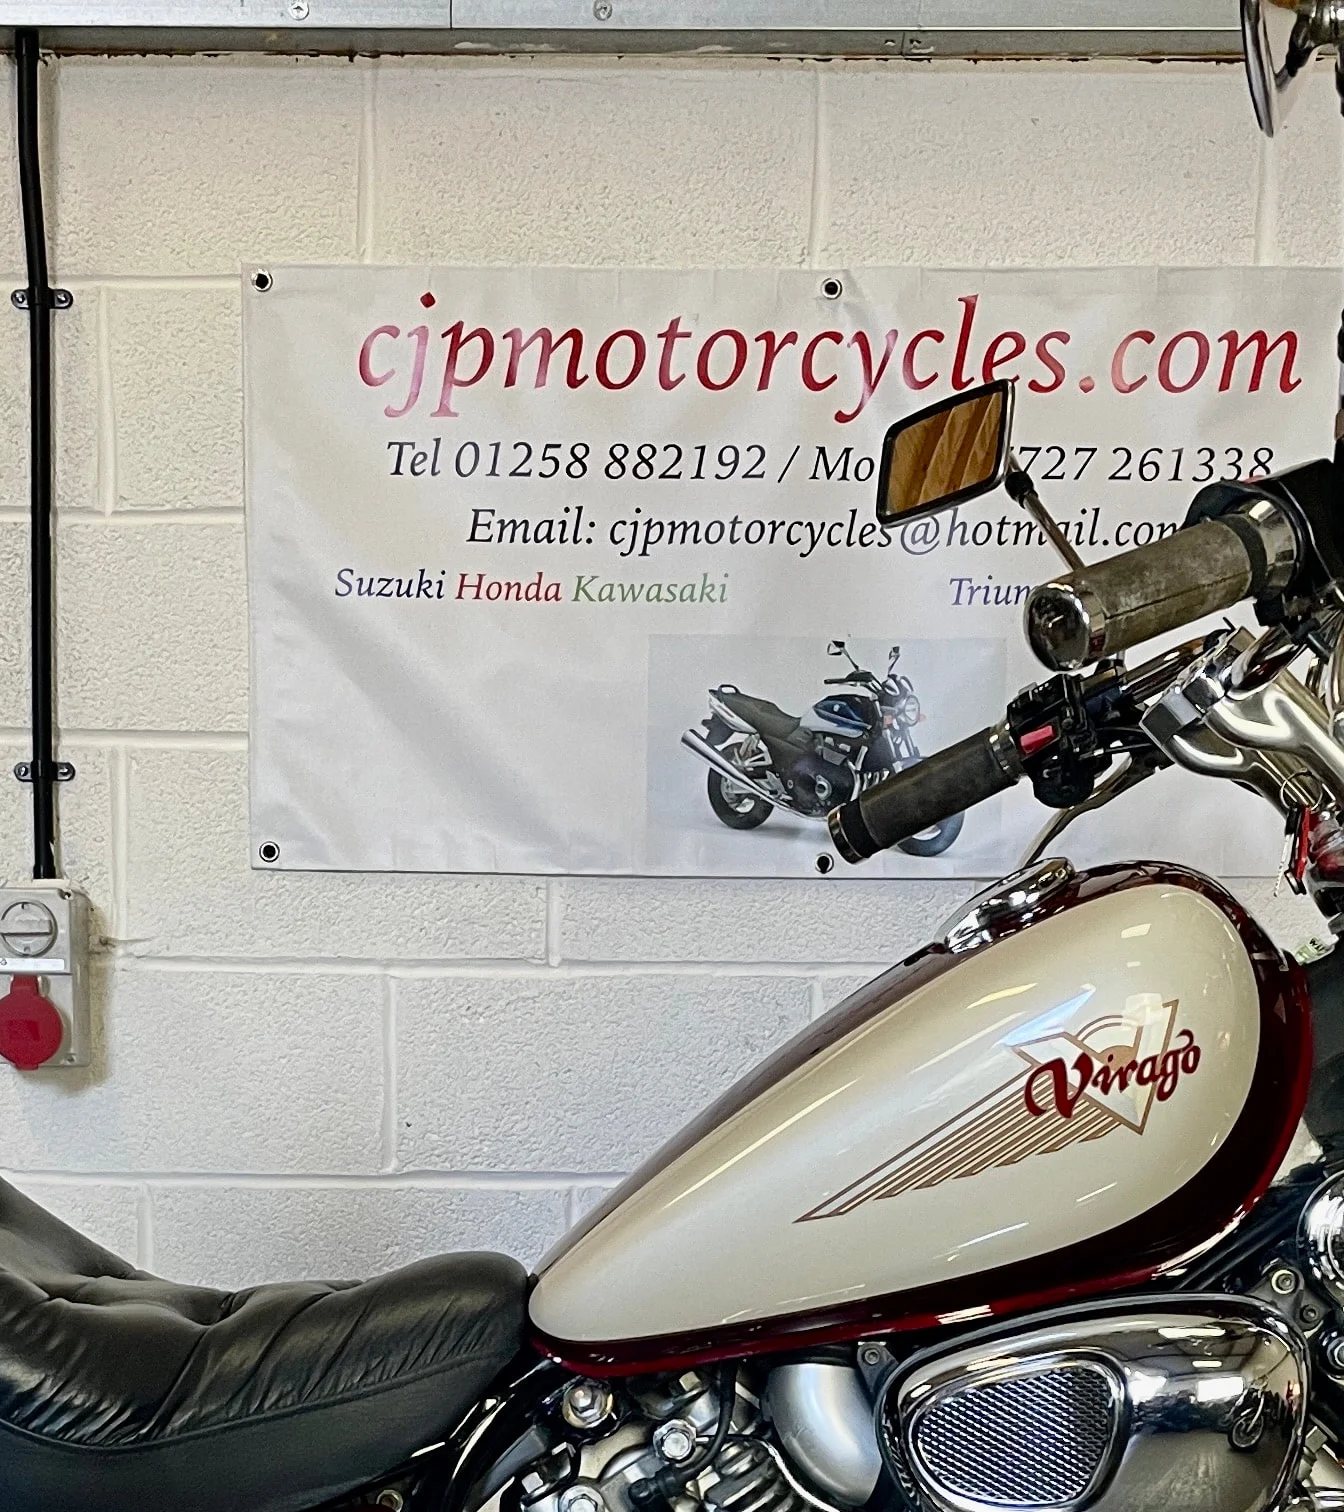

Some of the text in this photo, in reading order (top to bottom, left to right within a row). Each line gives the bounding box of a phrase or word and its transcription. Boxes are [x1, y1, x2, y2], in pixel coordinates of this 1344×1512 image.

[358, 291, 1303, 424] cjpmotorcycles.com
[387, 437, 441, 477] Tel
[455, 442, 590, 479] 01258
[605, 443, 767, 481] 882192
[1010, 446, 1097, 481] 727
[1108, 446, 1274, 482] 261338
[466, 506, 595, 545] Email:
[334, 567, 446, 602] Suzuki
[455, 570, 563, 604] Honda
[571, 572, 729, 606] Kawasaki
[1024, 1028, 1201, 1119] Virago
